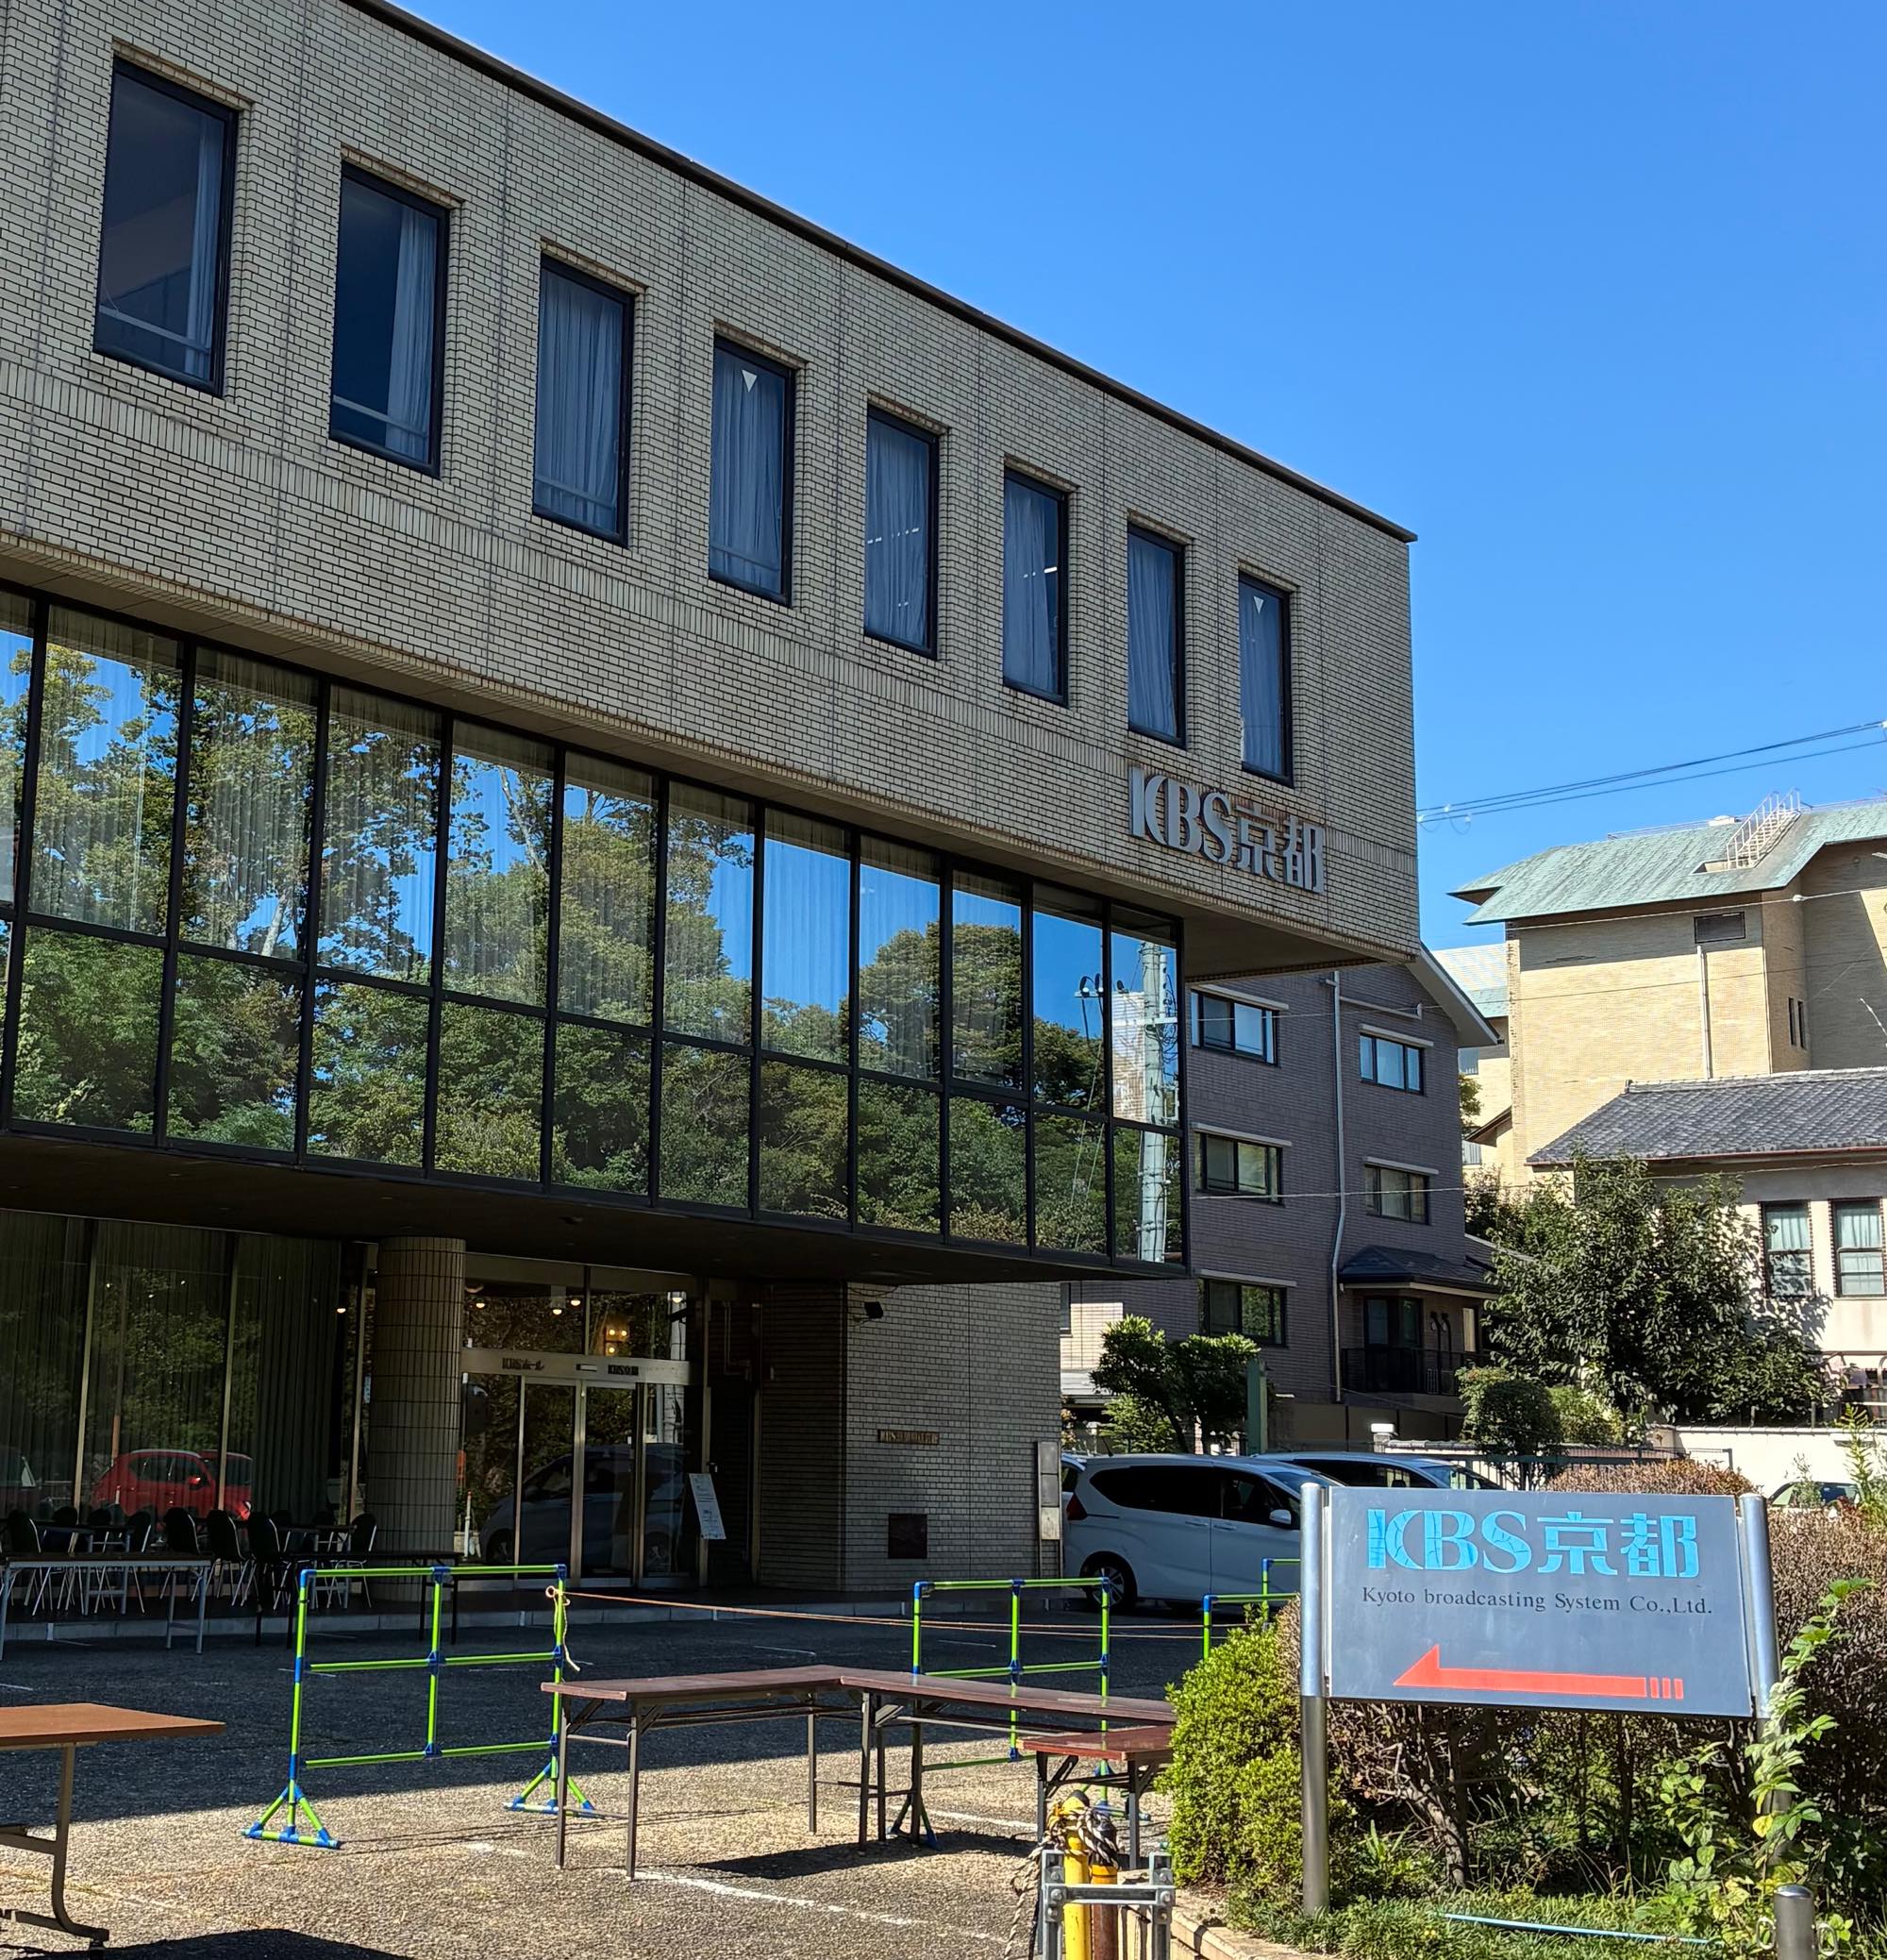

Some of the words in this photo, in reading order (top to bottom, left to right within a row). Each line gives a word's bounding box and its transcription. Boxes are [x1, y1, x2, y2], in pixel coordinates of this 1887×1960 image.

[1128, 767, 1327, 894] KBS京都
[1367, 1509, 1700, 1578] KBS京都
[1362, 1586, 1415, 1605] Kyoto
[1425, 1588, 1545, 1613] broadcasting
[1554, 1592, 1620, 1613] System
[1629, 1596, 1712, 1615] Co.,Ltd.
